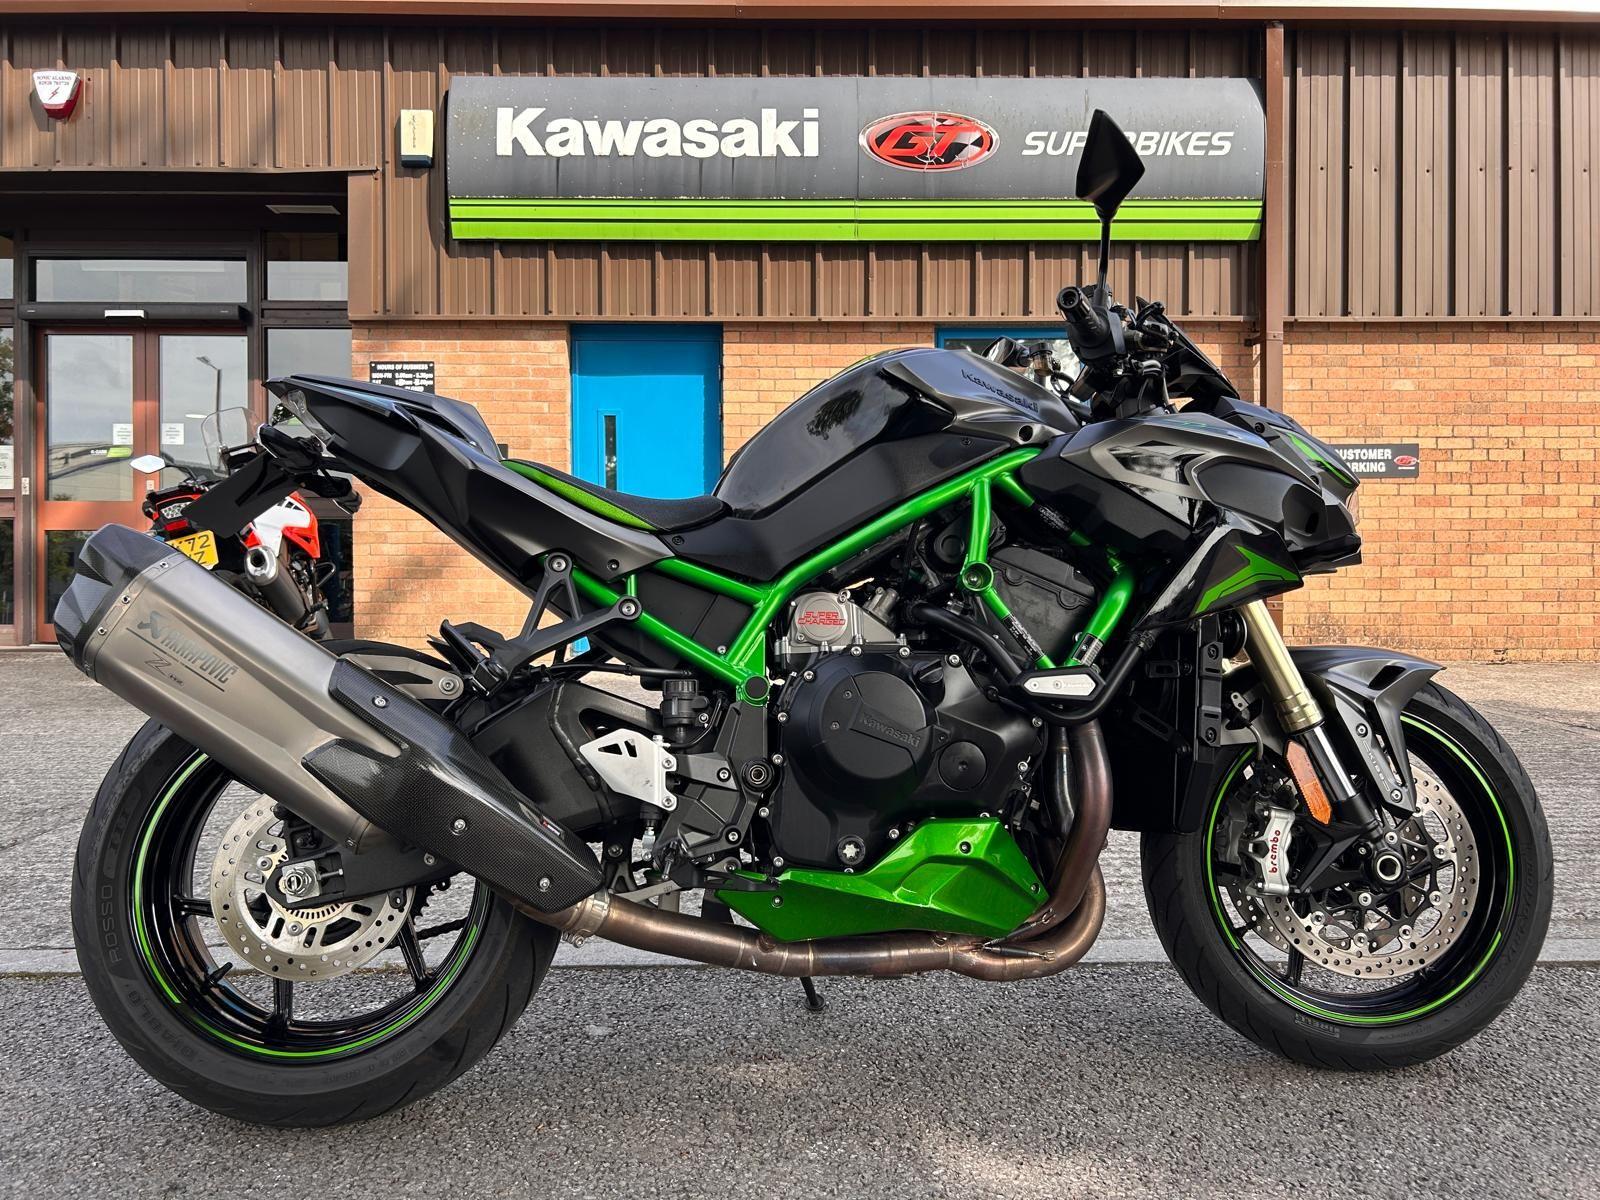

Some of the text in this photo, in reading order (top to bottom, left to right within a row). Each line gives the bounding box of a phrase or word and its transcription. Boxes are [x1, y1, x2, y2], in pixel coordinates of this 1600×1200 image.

[496, 107, 820, 157] Kawasaki
[879, 125, 982, 157] GT
[1022, 131, 1235, 156] SUPBIKES
[961, 369, 1039, 413] Kawasaki
[798, 618, 846, 626] CHARGED
[804, 611, 839, 619] SUPER
[862, 712, 921, 748] Kawasaki
[1268, 829, 1281, 873] brembo
[102, 885, 122, 964] ROSSO
